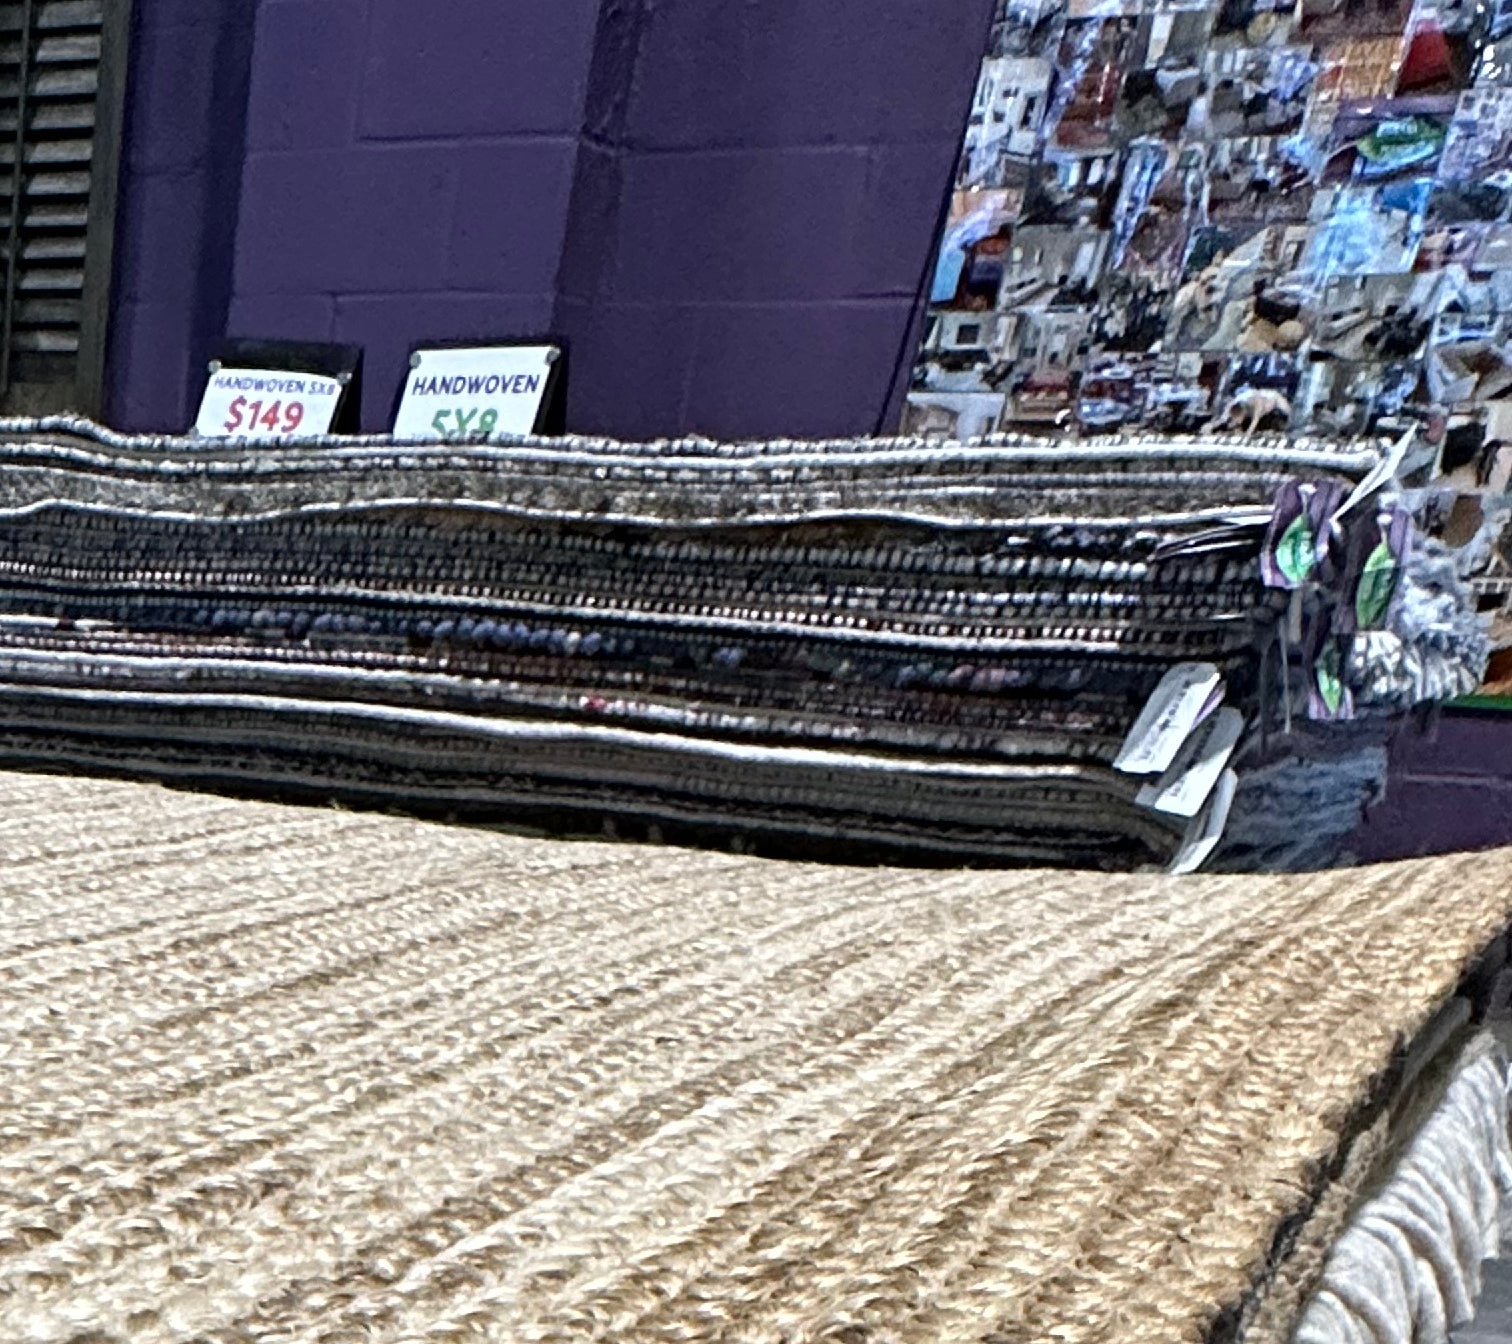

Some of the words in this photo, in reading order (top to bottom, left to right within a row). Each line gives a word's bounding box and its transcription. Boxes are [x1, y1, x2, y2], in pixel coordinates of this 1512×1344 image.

[214, 376, 305, 393] HANDWOVEN
[412, 373, 541, 396] HANDWOVEN
[223, 394, 305, 434] $149
